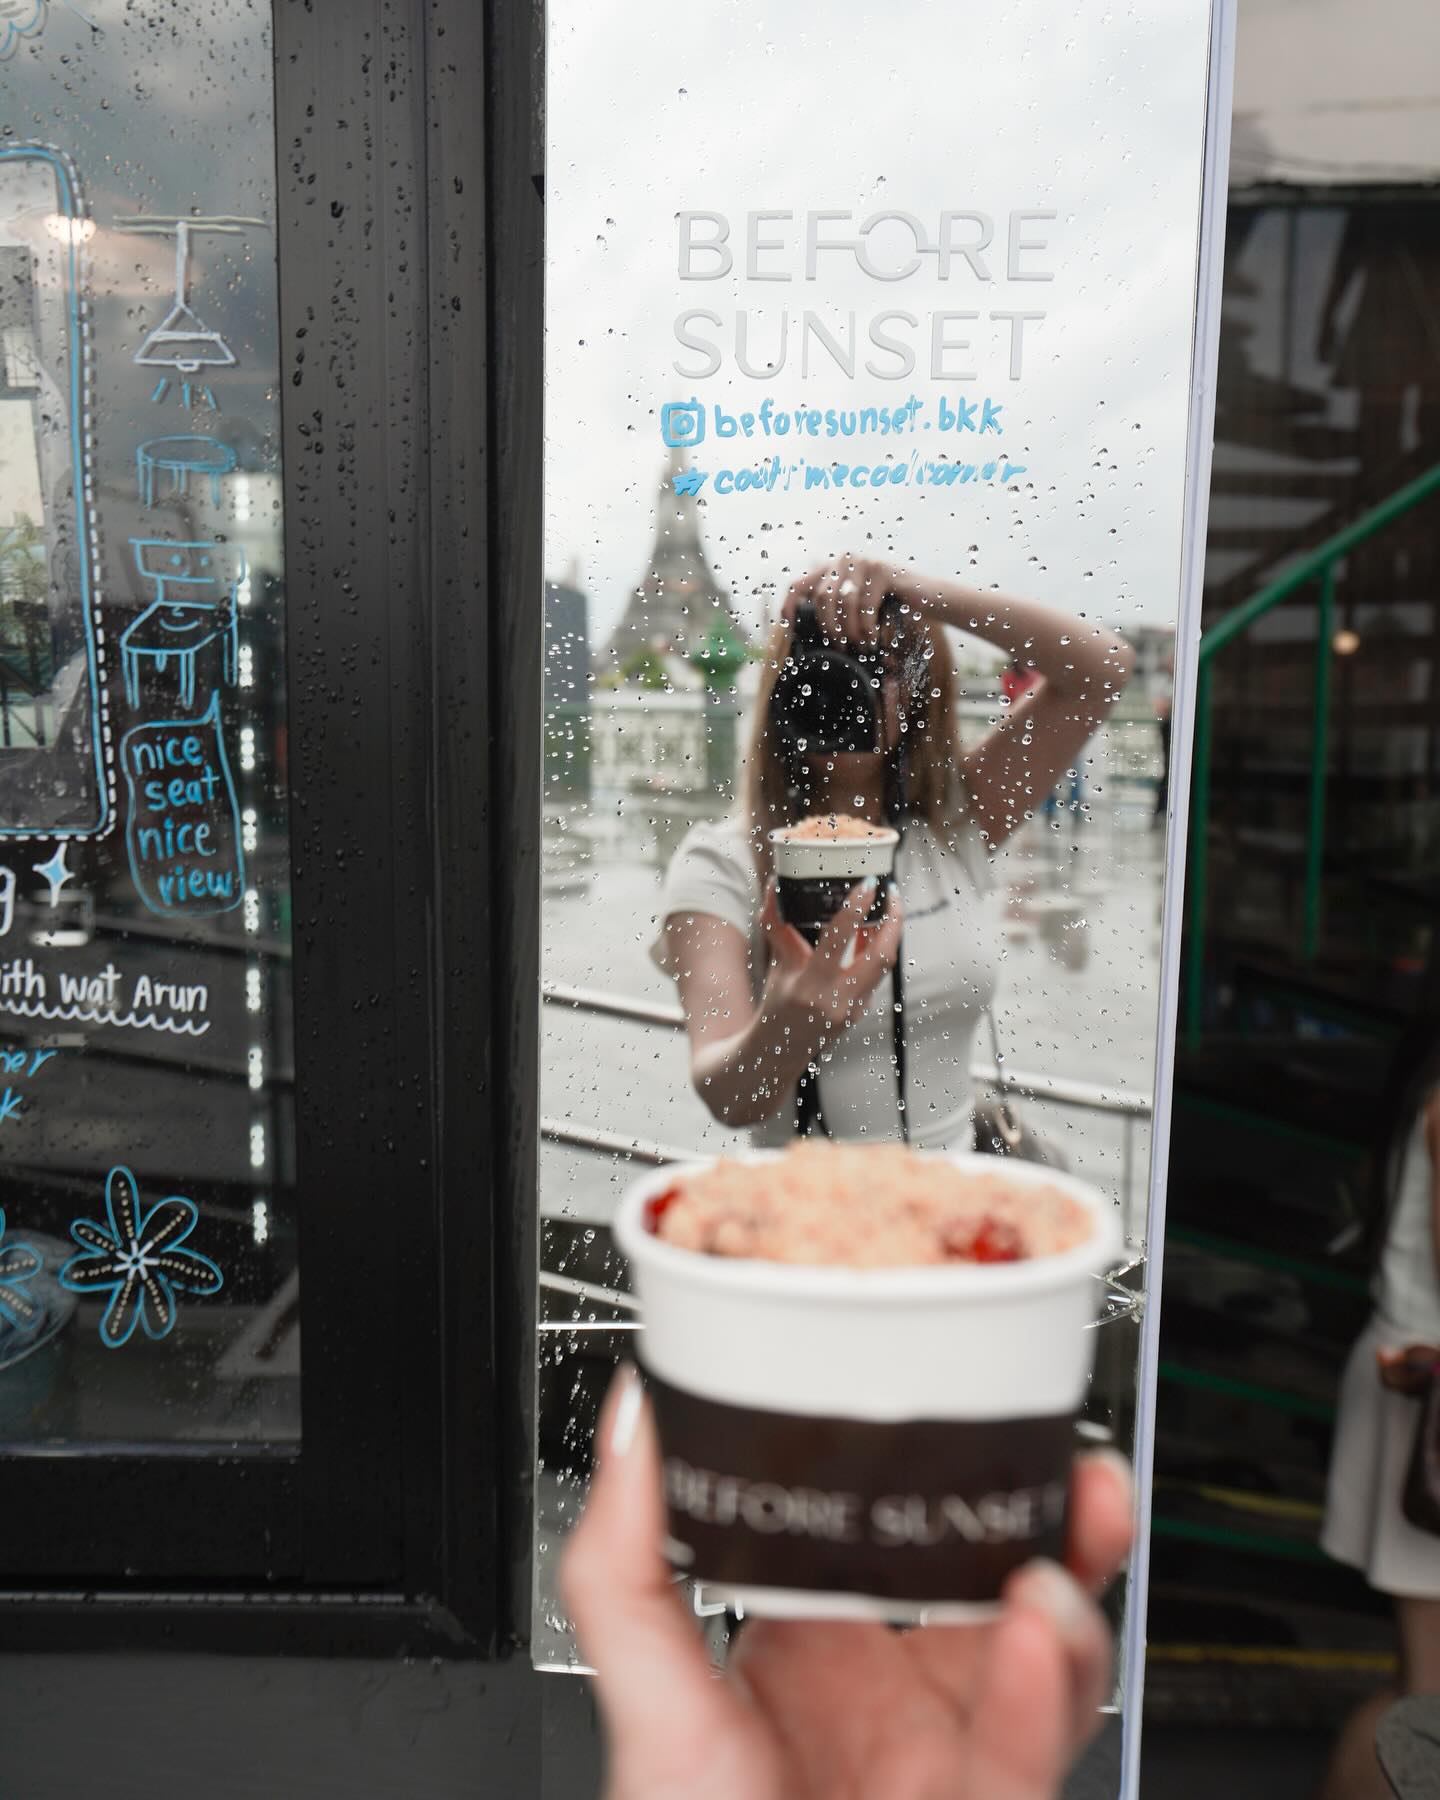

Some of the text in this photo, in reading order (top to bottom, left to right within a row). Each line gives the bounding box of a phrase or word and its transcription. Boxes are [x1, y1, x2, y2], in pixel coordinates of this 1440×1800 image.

[678, 210, 1058, 282] BEFORE
[672, 308, 1047, 381] SUNSET
[714, 395, 1004, 438] beforesunset.bkk
[132, 736, 203, 775] nice
[144, 766, 220, 811] seat
[138, 818, 216, 861] nice
[132, 974, 208, 1012] Arun
